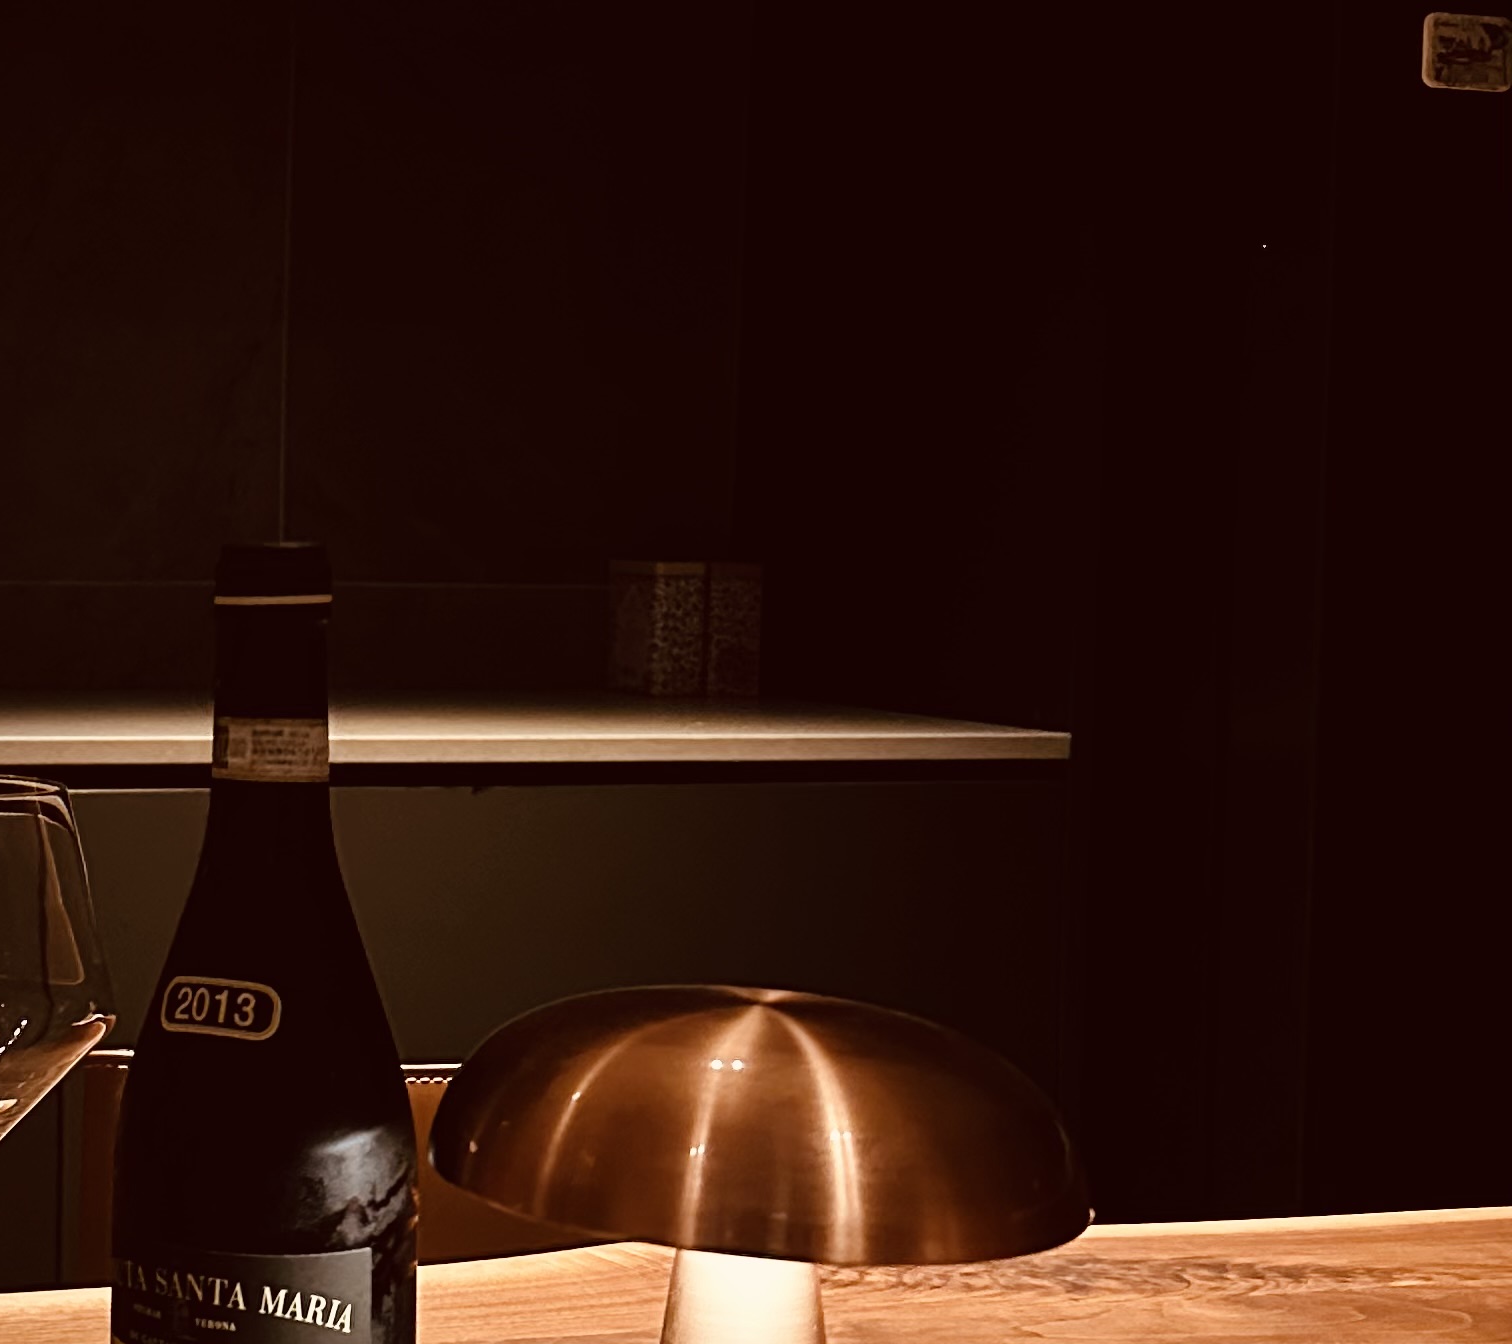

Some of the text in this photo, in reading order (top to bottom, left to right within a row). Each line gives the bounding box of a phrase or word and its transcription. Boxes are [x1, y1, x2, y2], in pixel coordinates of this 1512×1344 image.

[174, 987, 256, 1027] 2013
[155, 1266, 247, 1312] SANTA
[258, 1285, 352, 1334] MARIA
[195, 1317, 237, 1332] VERONA
